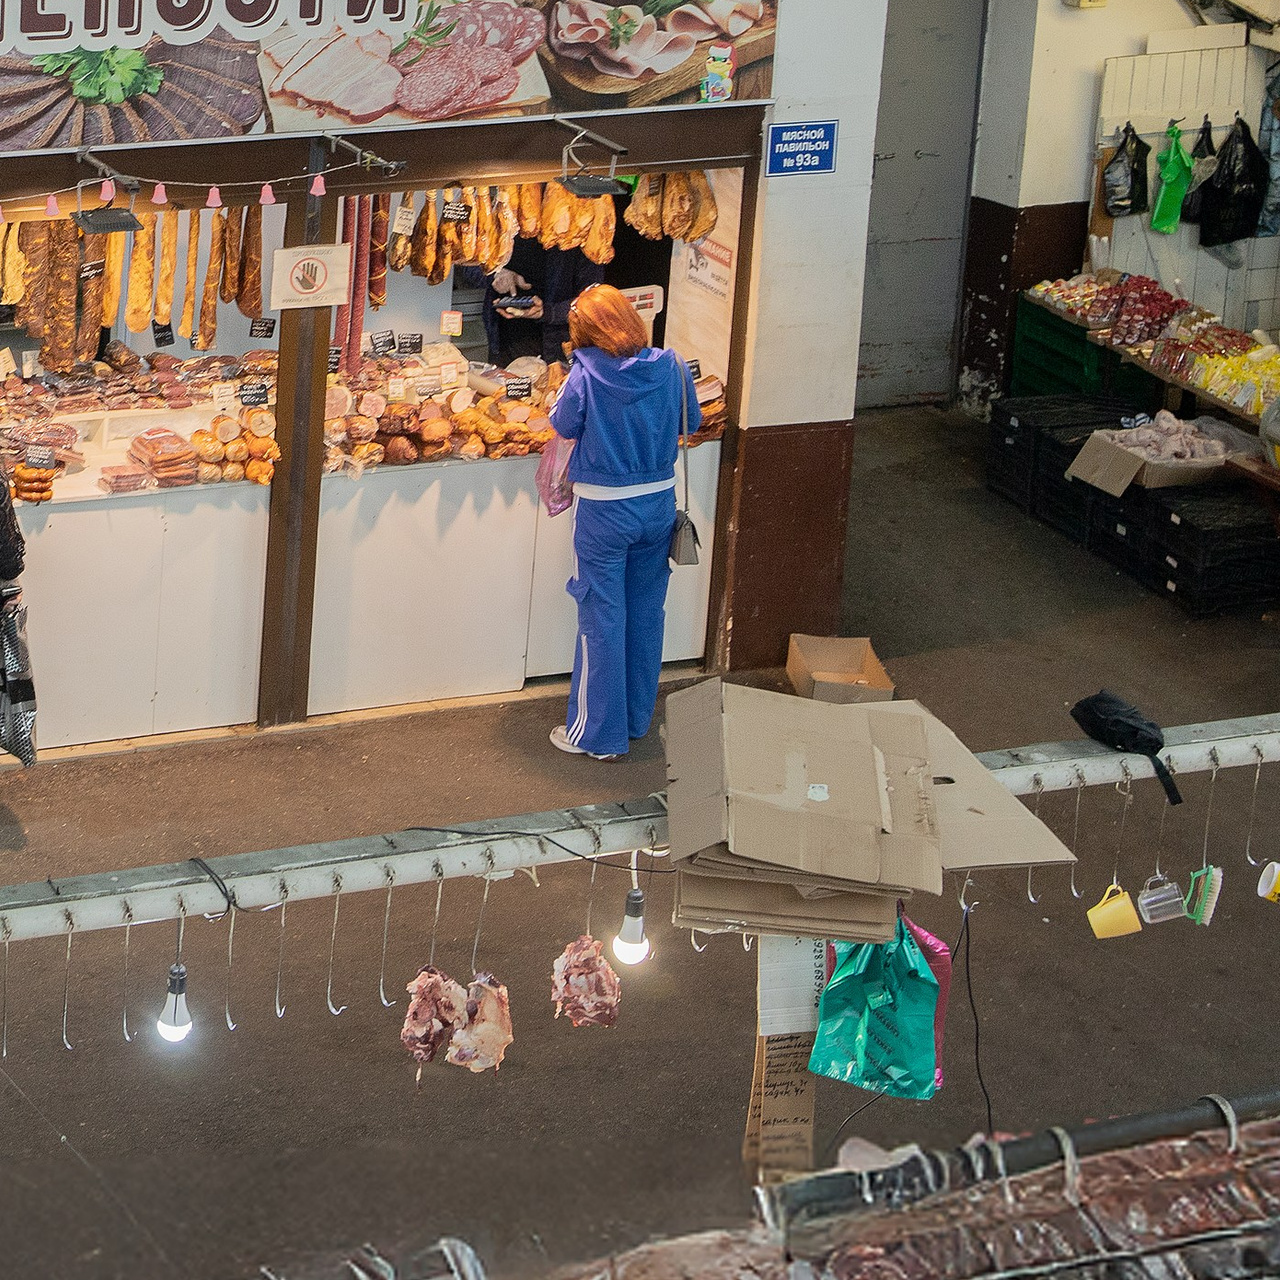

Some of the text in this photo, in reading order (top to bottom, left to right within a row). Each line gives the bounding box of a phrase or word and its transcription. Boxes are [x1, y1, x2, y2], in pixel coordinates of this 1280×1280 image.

[782, 128, 825, 141] МЯСНОЙ
[775, 141, 830, 153] ПАВИЛЬОН
[795, 153, 820, 167] 93а
